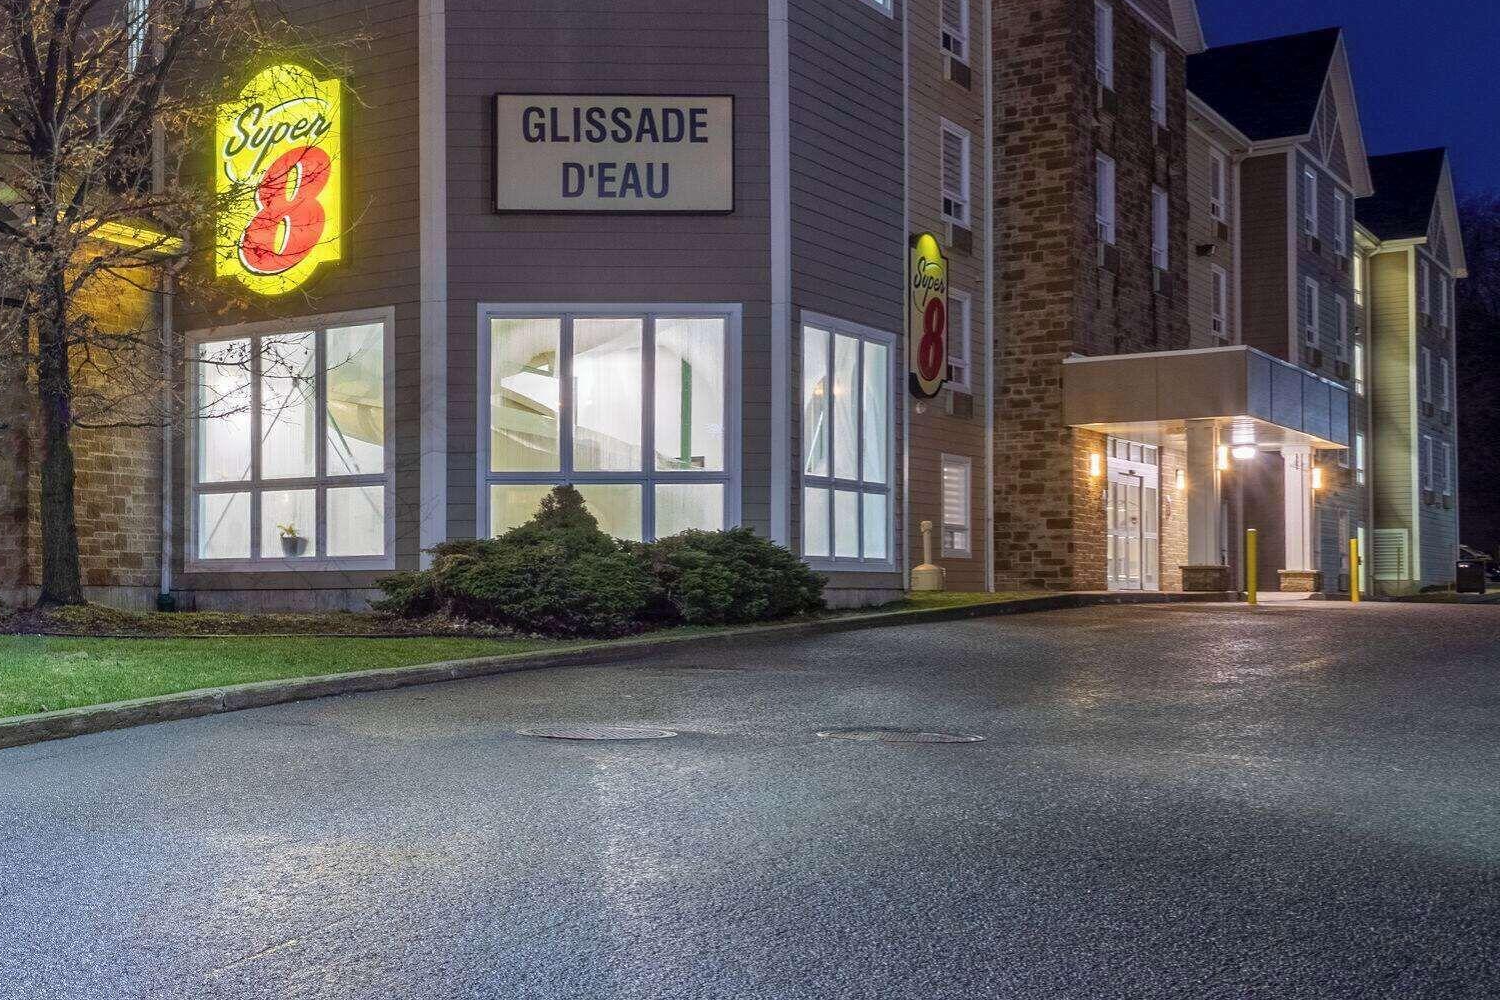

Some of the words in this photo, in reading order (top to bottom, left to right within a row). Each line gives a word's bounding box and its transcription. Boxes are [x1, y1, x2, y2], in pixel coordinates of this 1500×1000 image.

[225, 103, 333, 176] Super
[522, 106, 709, 144] GLISSADE
[238, 146, 332, 277] 8
[562, 162, 670, 199] D'EAU
[913, 256, 946, 307] Super
[917, 297, 945, 381] 8
